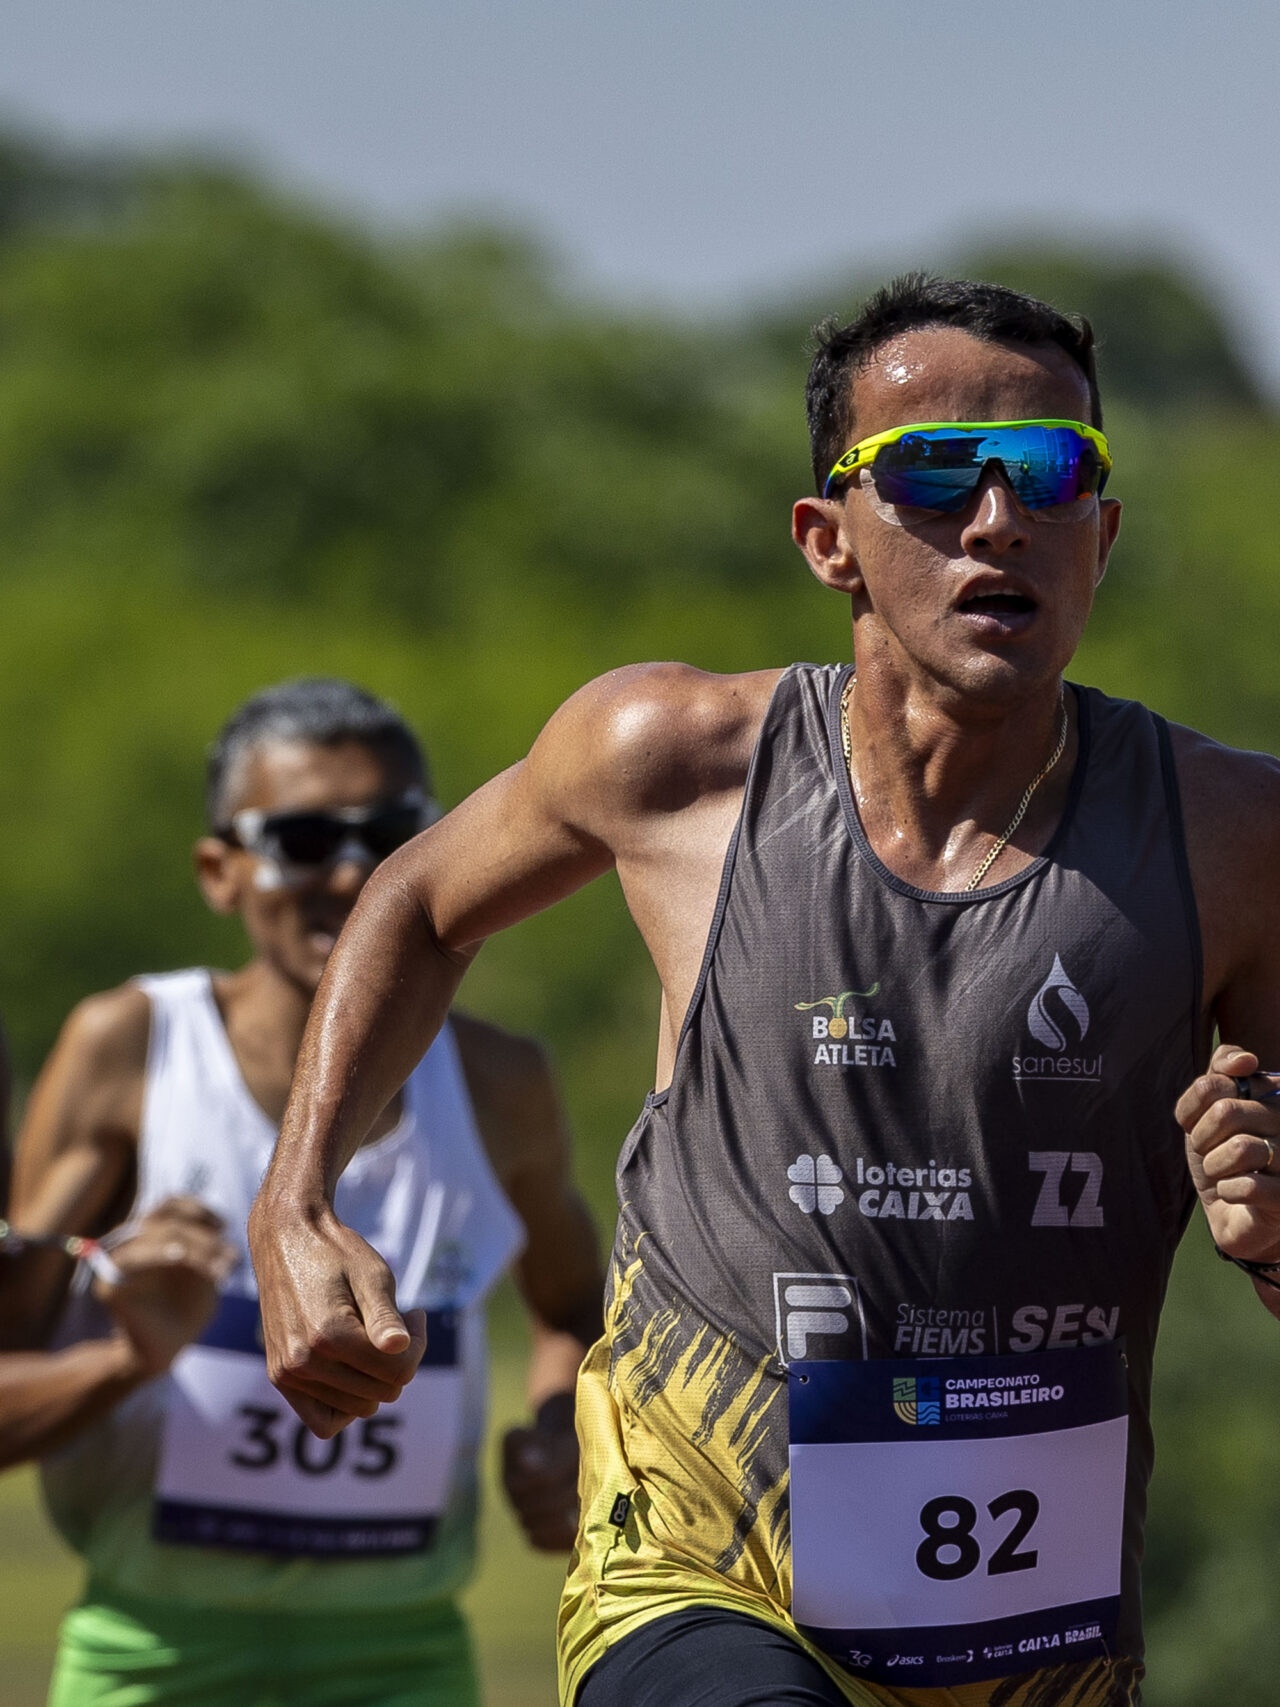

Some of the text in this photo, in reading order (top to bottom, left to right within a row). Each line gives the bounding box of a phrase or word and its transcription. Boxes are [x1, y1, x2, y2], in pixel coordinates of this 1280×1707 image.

[812, 1015, 897, 1042] BOLSA
[813, 1044, 897, 1068] ATLETA
[1011, 1054, 1102, 1076] sanesul
[856, 1158, 972, 1188] loterias
[858, 1190, 975, 1221] CAIXA
[896, 1303, 985, 1327] Sistema
[893, 1326, 987, 1355] FIEMS
[945, 1374, 1040, 1390] CAMPEONATO
[945, 1385, 1065, 1409] BRASILEIRO
[229, 1405, 404, 1479] 305
[915, 1488, 1040, 1581] 82
[1017, 1633, 1061, 1653] CAIXA
[1064, 1625, 1102, 1645] BRASIL
